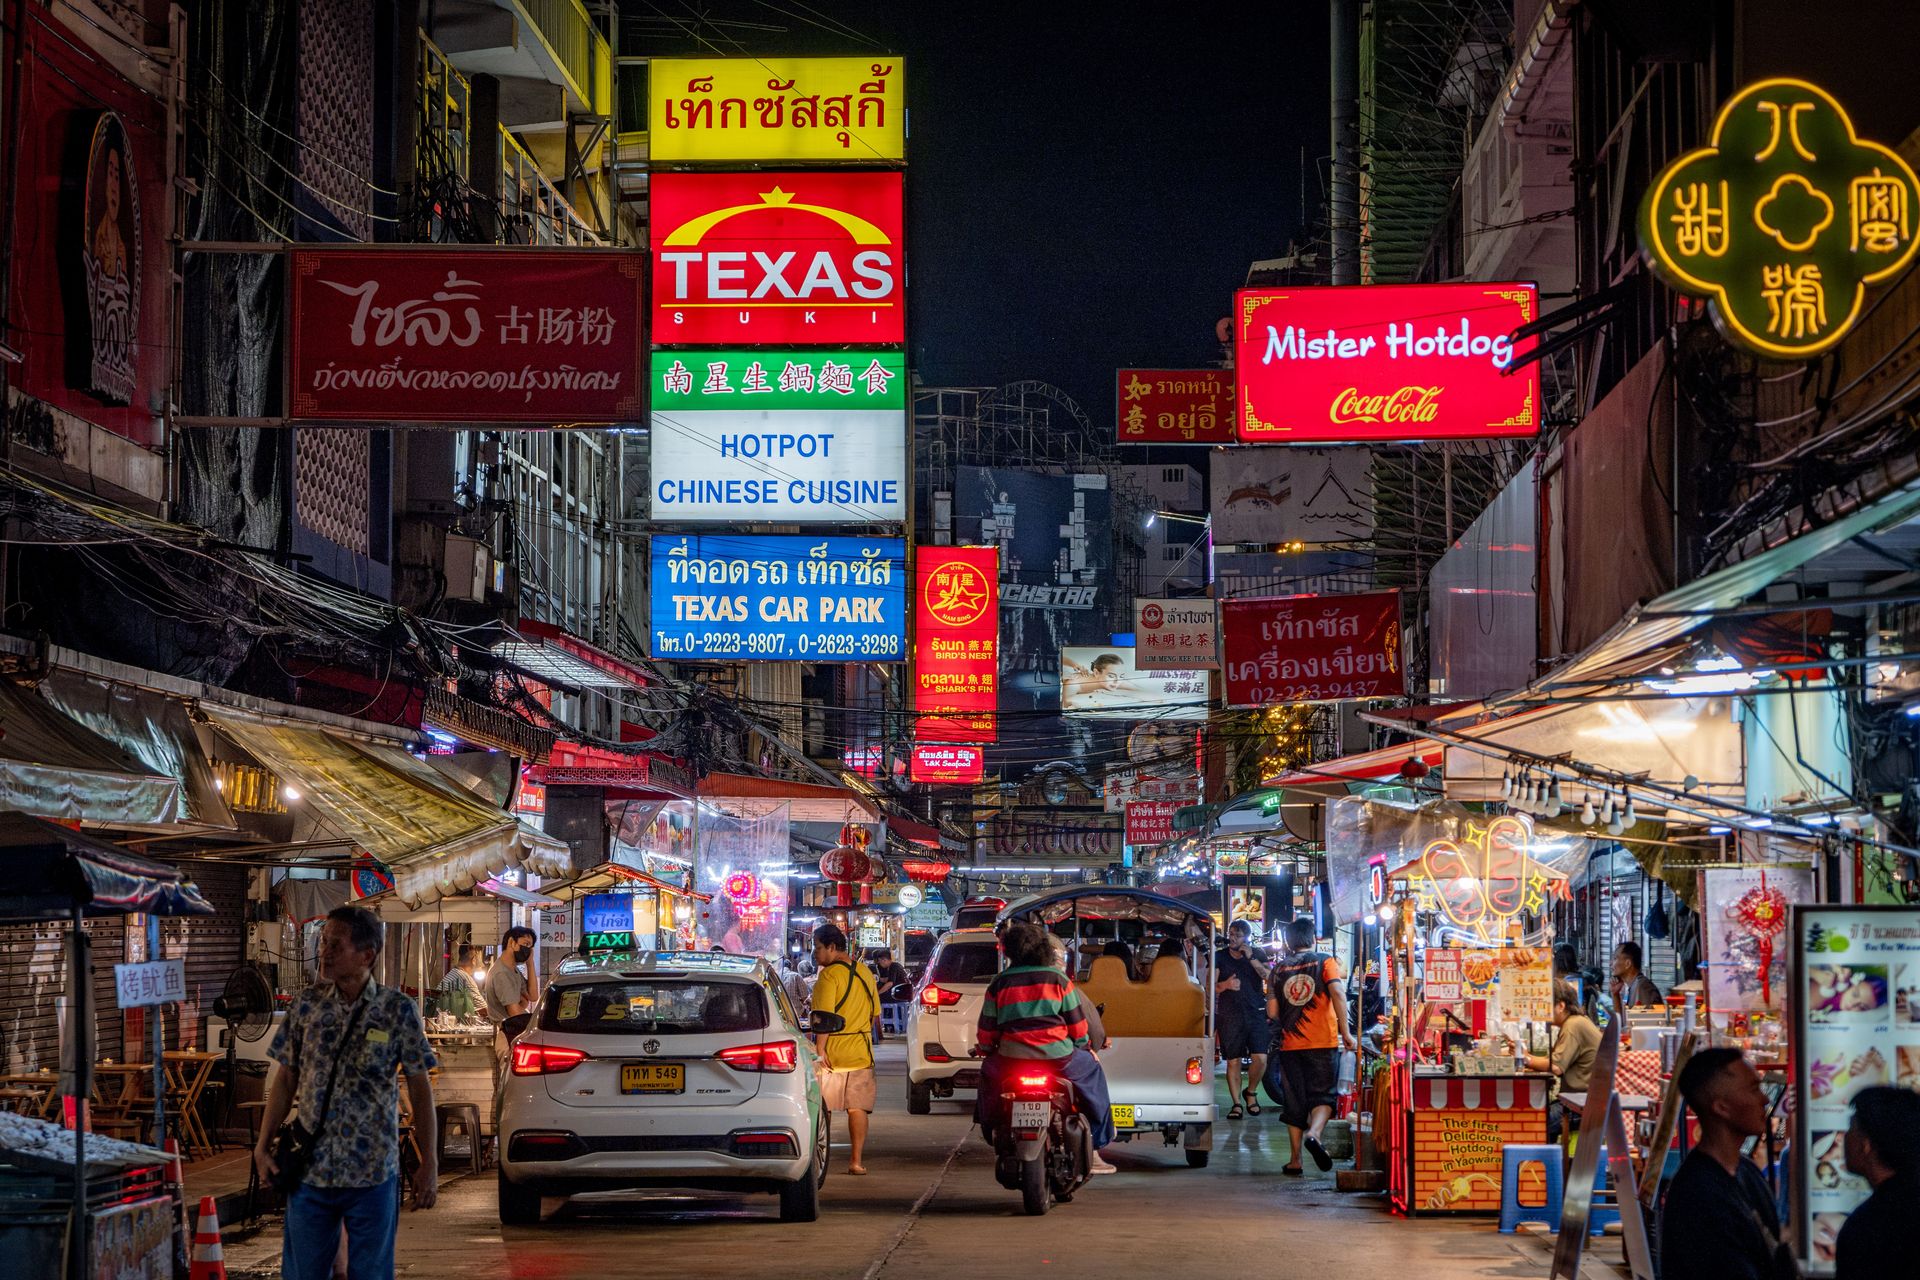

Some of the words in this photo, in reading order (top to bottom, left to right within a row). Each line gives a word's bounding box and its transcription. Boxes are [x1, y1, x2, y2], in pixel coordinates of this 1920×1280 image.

[664, 63, 893, 148] เท็กซัสสุกี้
[661, 251, 894, 299] TEXAS
[495, 306, 616, 347] 古肠粉
[1262, 324, 1376, 365] Mister
[1386, 318, 1514, 368] Hotdog
[663, 359, 895, 395] 南星生鍋麵食
[1156, 373, 1221, 396] ราดหน้า
[1330, 386, 1445, 424] Coca-Cola
[721, 434, 834, 458] HOTPOT
[657, 480, 778, 504] CHINESE
[787, 480, 897, 504] CUISINE
[667, 538, 788, 586] ที่จอดรถ
[797, 541, 892, 586] เท็กซัส
[937, 573, 950, 587] 南
[961, 574, 974, 587] 星
[672, 595, 748, 622] TEXAS
[759, 596, 809, 622] CAR
[819, 596, 885, 623] PARK
[942, 613, 957, 622] NAM
[957, 614, 972, 623] SING
[1261, 608, 1360, 641] เท็กซัส
[799, 633, 899, 655] 0-2623-3298
[931, 637, 965, 651] รังนก
[1145, 633, 1215, 647] 林明記茶
[936, 652, 966, 660] BIRD'S
[969, 652, 993, 660] NEST
[921, 673, 964, 689] หูฉลาม
[935, 685, 976, 694] SHARK'S
[978, 685, 993, 694] FIN
[972, 721, 993, 730] BBQ
[1131, 832, 1148, 842] LIM
[555, 914, 566, 925] 40
[555, 932, 566, 942] 20
[586, 933, 630, 948] TAXI
[120, 967, 183, 1001] 烤鱿鱼
[656, 1067, 678, 1080] 549
[1114, 1107, 1133, 1119] 552
[1018, 1118, 1043, 1127] 1100
[1441, 1117, 1469, 1129] The
[1471, 1119, 1500, 1132] first
[1442, 1131, 1503, 1143] Delicious
[1449, 1143, 1494, 1156] Hotdog
[1442, 1159, 1454, 1172] in
[1455, 1156, 1502, 1167] Yaowara
